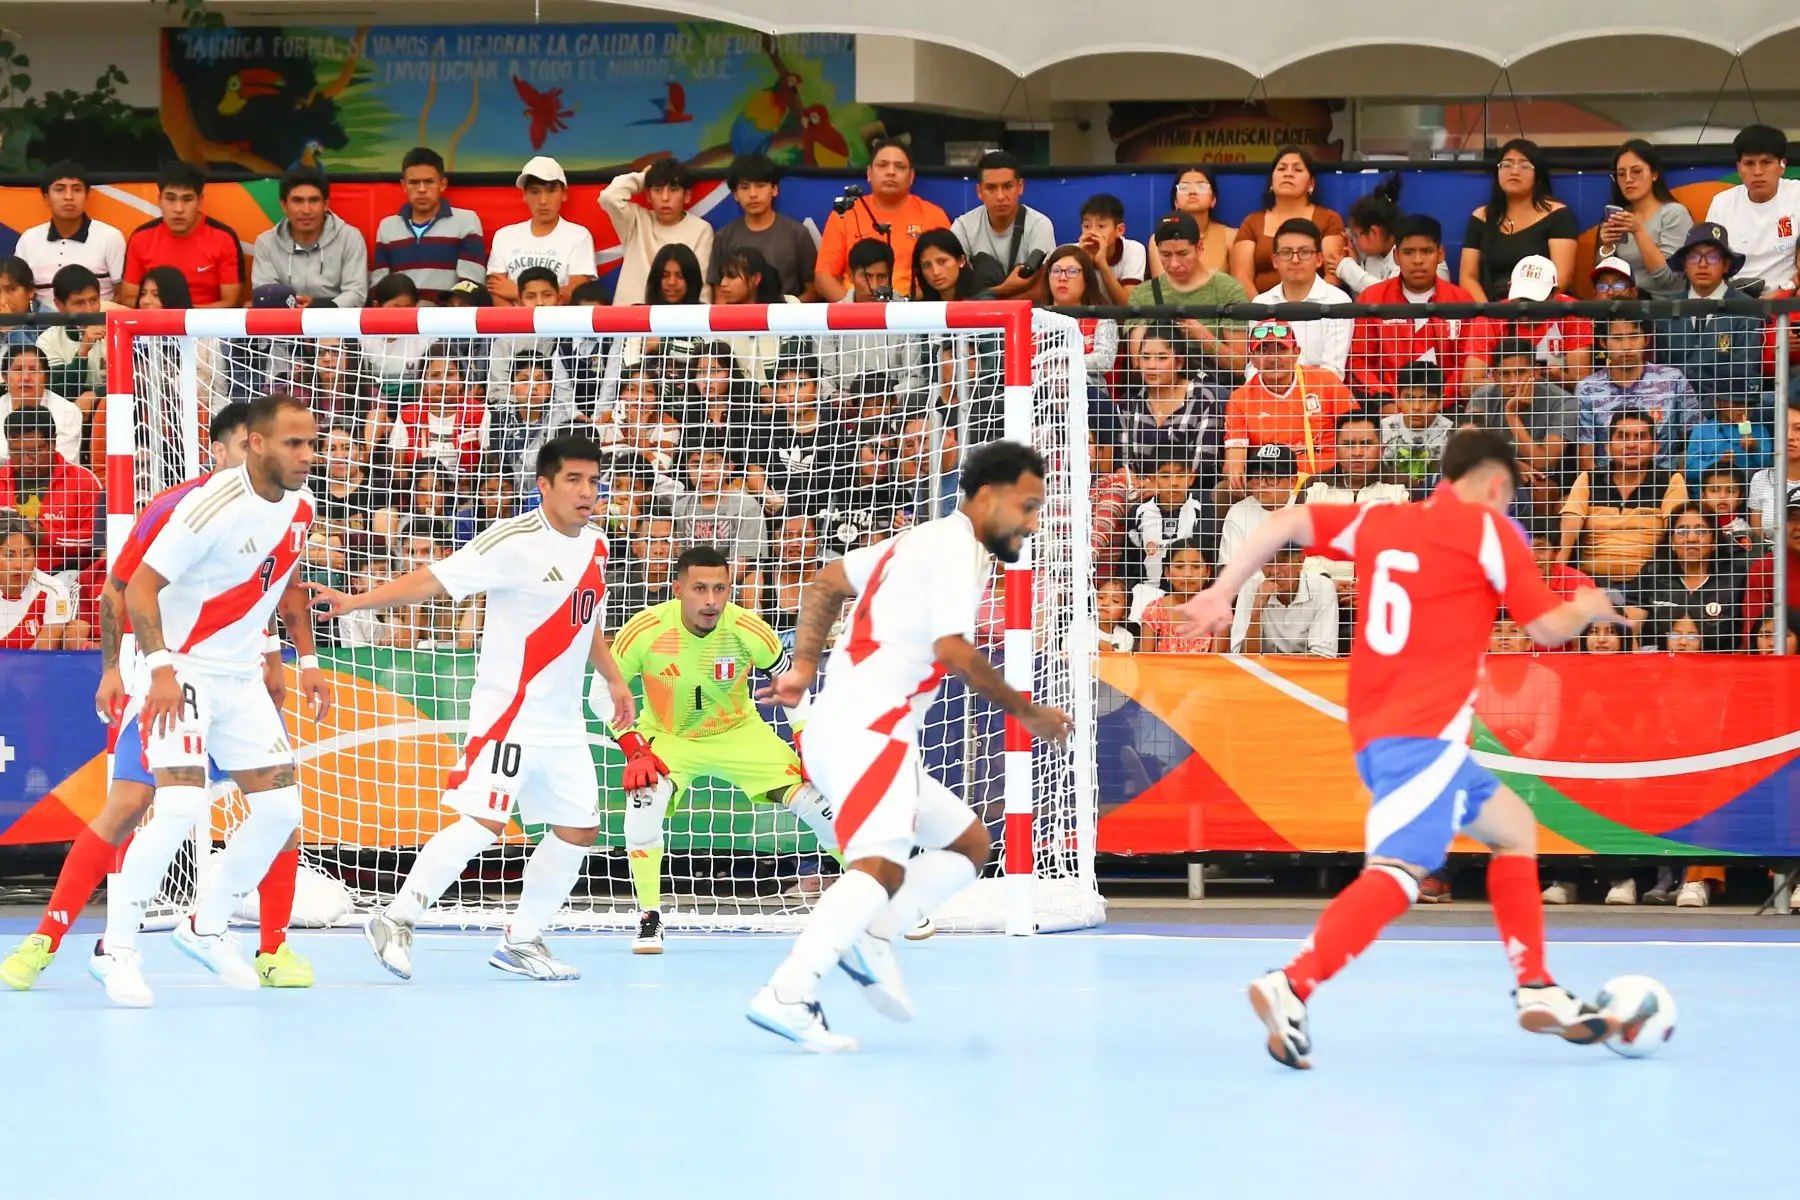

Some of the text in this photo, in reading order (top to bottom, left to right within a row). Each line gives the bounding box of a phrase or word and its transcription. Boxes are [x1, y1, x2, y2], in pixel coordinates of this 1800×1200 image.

[372, 34, 429, 56] VAMOS
[433, 35, 448, 57] A
[546, 33, 569, 56] LA
[575, 33, 656, 57] CALIDAD
[578, 59, 600, 82] EL
[508, 256, 562, 273] SACRIFICE
[259, 556, 276, 592] 9
[571, 588, 596, 626] 10
[1365, 548, 1420, 656] 6
[695, 685, 702, 710] 1
[491, 742, 521, 777] 10
